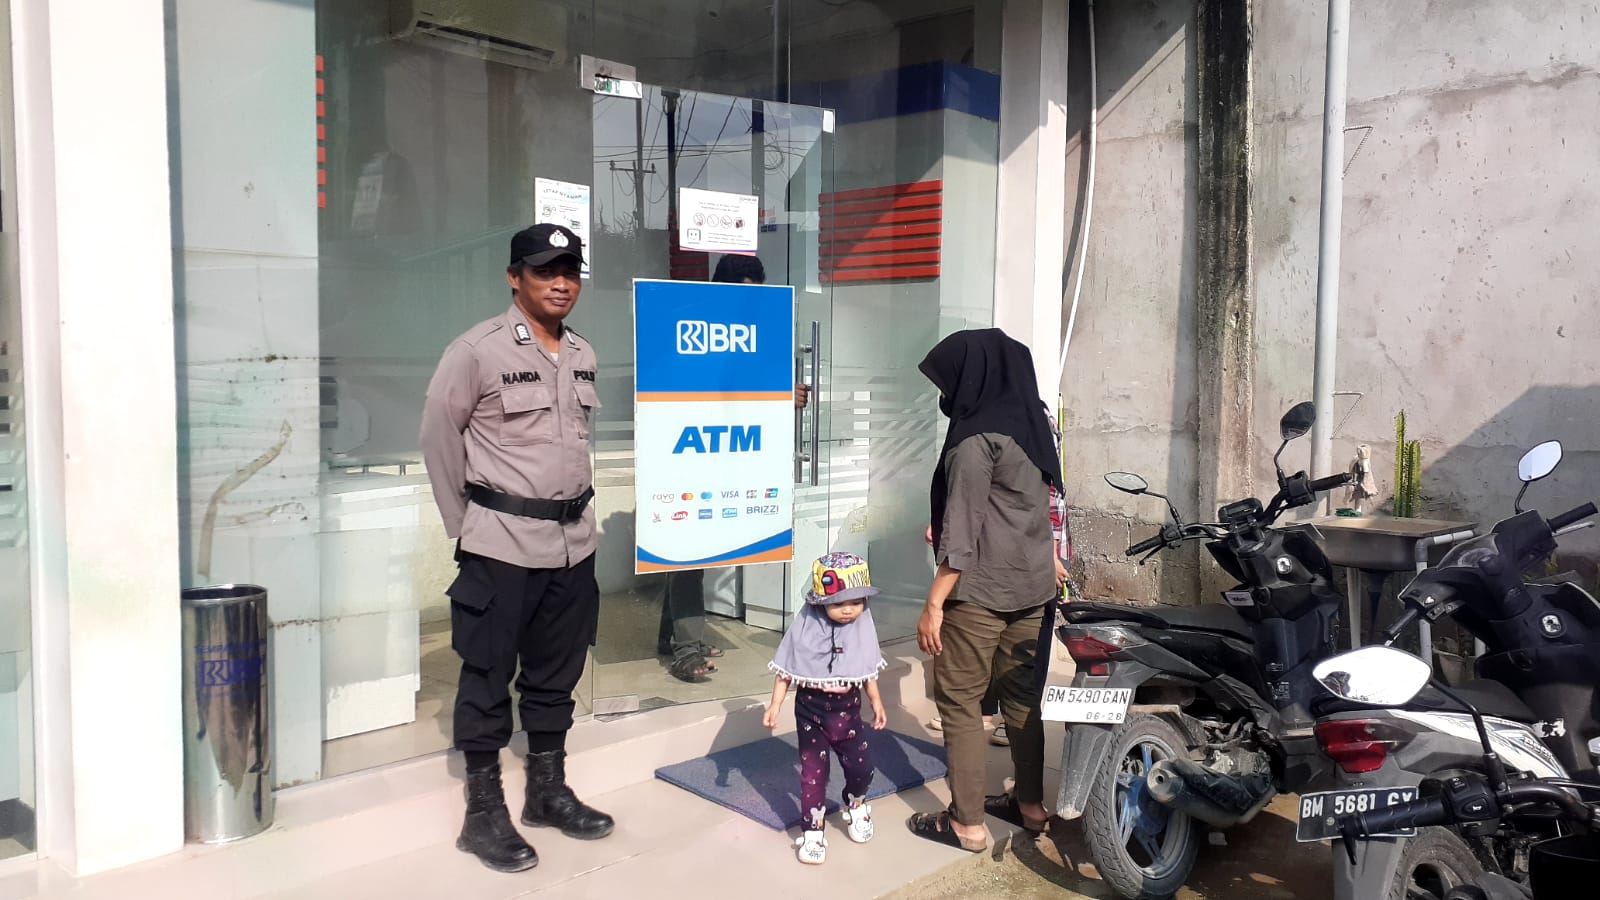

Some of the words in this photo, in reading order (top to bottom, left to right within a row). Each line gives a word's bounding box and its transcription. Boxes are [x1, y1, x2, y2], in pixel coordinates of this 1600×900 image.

[709, 322, 757, 353] BRI
[501, 371, 542, 385] NANDA
[672, 424, 762, 455] ATM
[721, 489, 740, 499] VISA
[746, 504, 779, 515] BRIZZI
[1046, 688, 1066, 703] BM
[1068, 689, 1101, 704] 5490
[1102, 689, 1129, 705] GAN
[1302, 796, 1324, 819] BM
[1334, 793, 1376, 815] 5681
